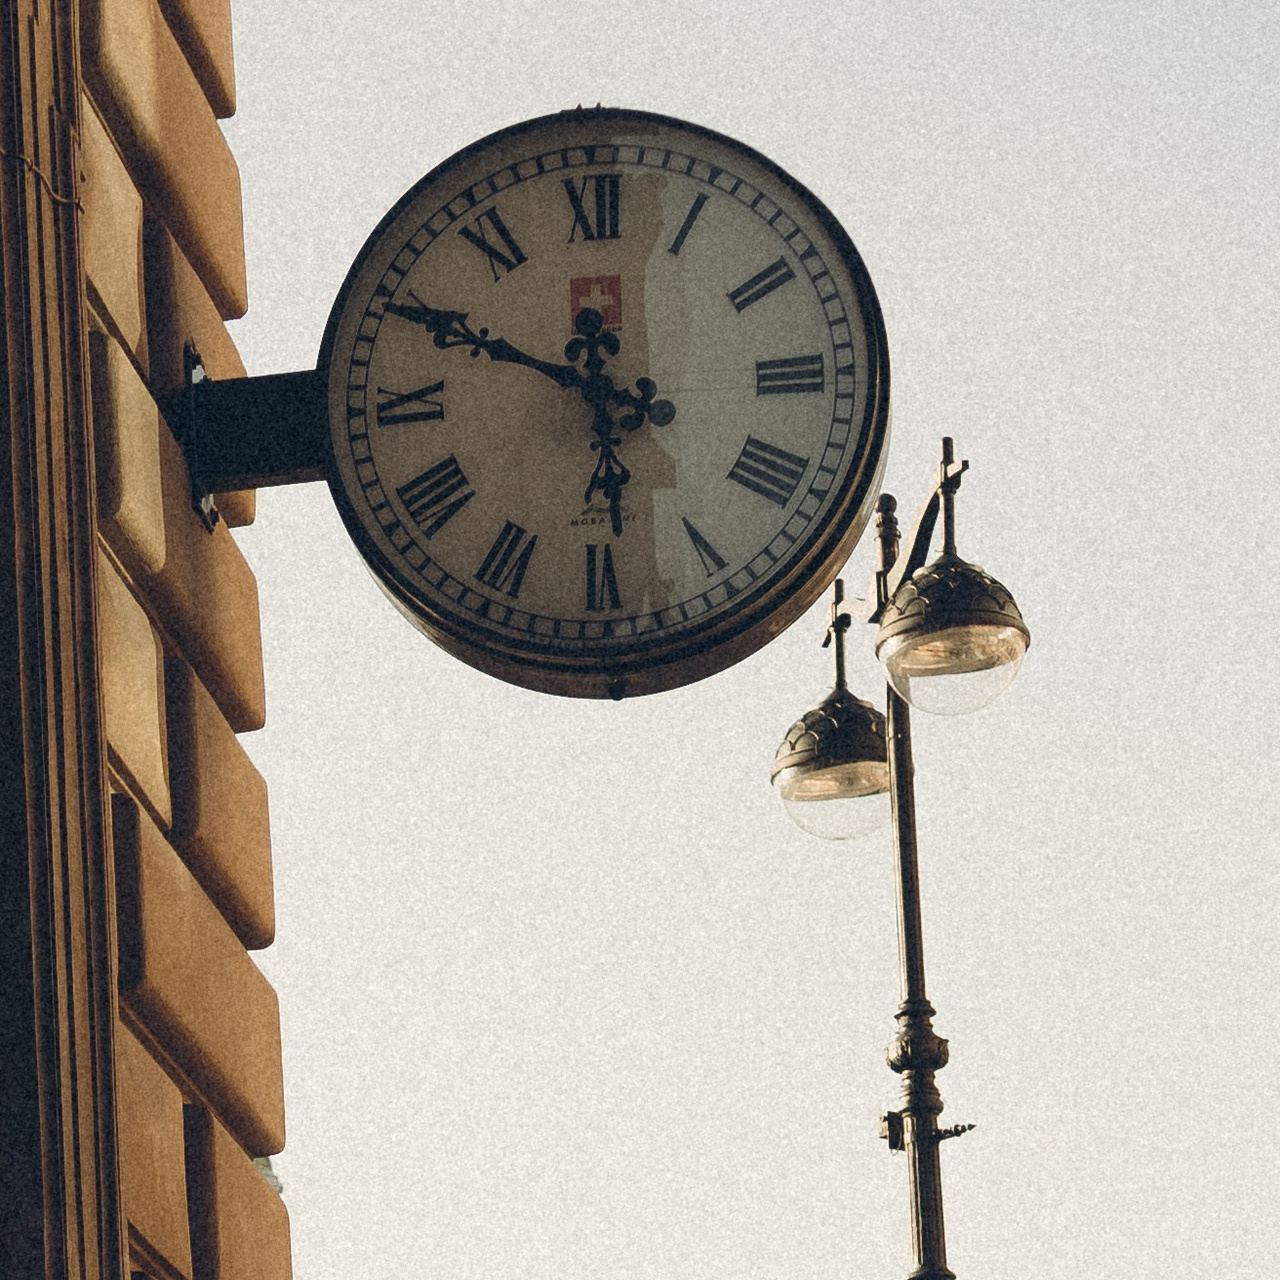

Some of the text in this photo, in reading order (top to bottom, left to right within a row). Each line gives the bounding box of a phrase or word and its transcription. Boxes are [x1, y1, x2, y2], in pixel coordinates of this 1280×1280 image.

[561, 174, 622, 243] XII
[668, 192, 710, 255] I
[457, 206, 528, 283] XI
[726, 255, 796, 314] II
[377, 379, 444, 428] IX
[756, 352, 824, 397] III
[395, 453, 476, 541] VIII
[725, 434, 810, 509] IIII
[570, 513, 637, 527] MOBAME
[682, 516, 729, 578] V
[473, 519, 538, 599] VII
[585, 543, 623, 612] VI
